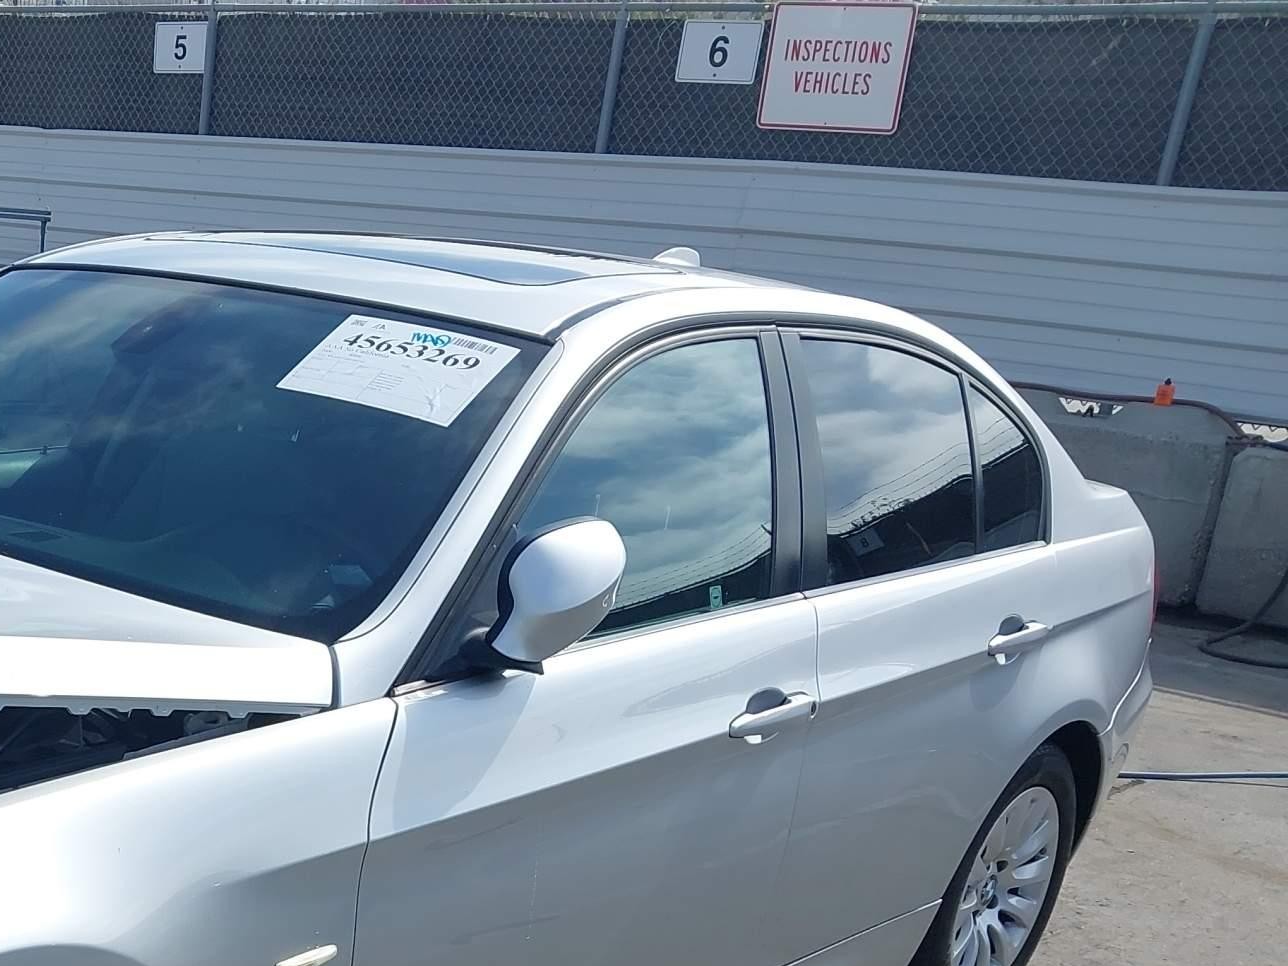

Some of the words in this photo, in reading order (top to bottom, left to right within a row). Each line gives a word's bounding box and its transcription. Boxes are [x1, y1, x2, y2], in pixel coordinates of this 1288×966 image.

[173, 34, 187, 60] 5
[708, 35, 731, 68] 6
[784, 38, 893, 65] INSPECTIONS
[793, 71, 873, 96] VEHICLES
[343, 333, 481, 370] 45653269
